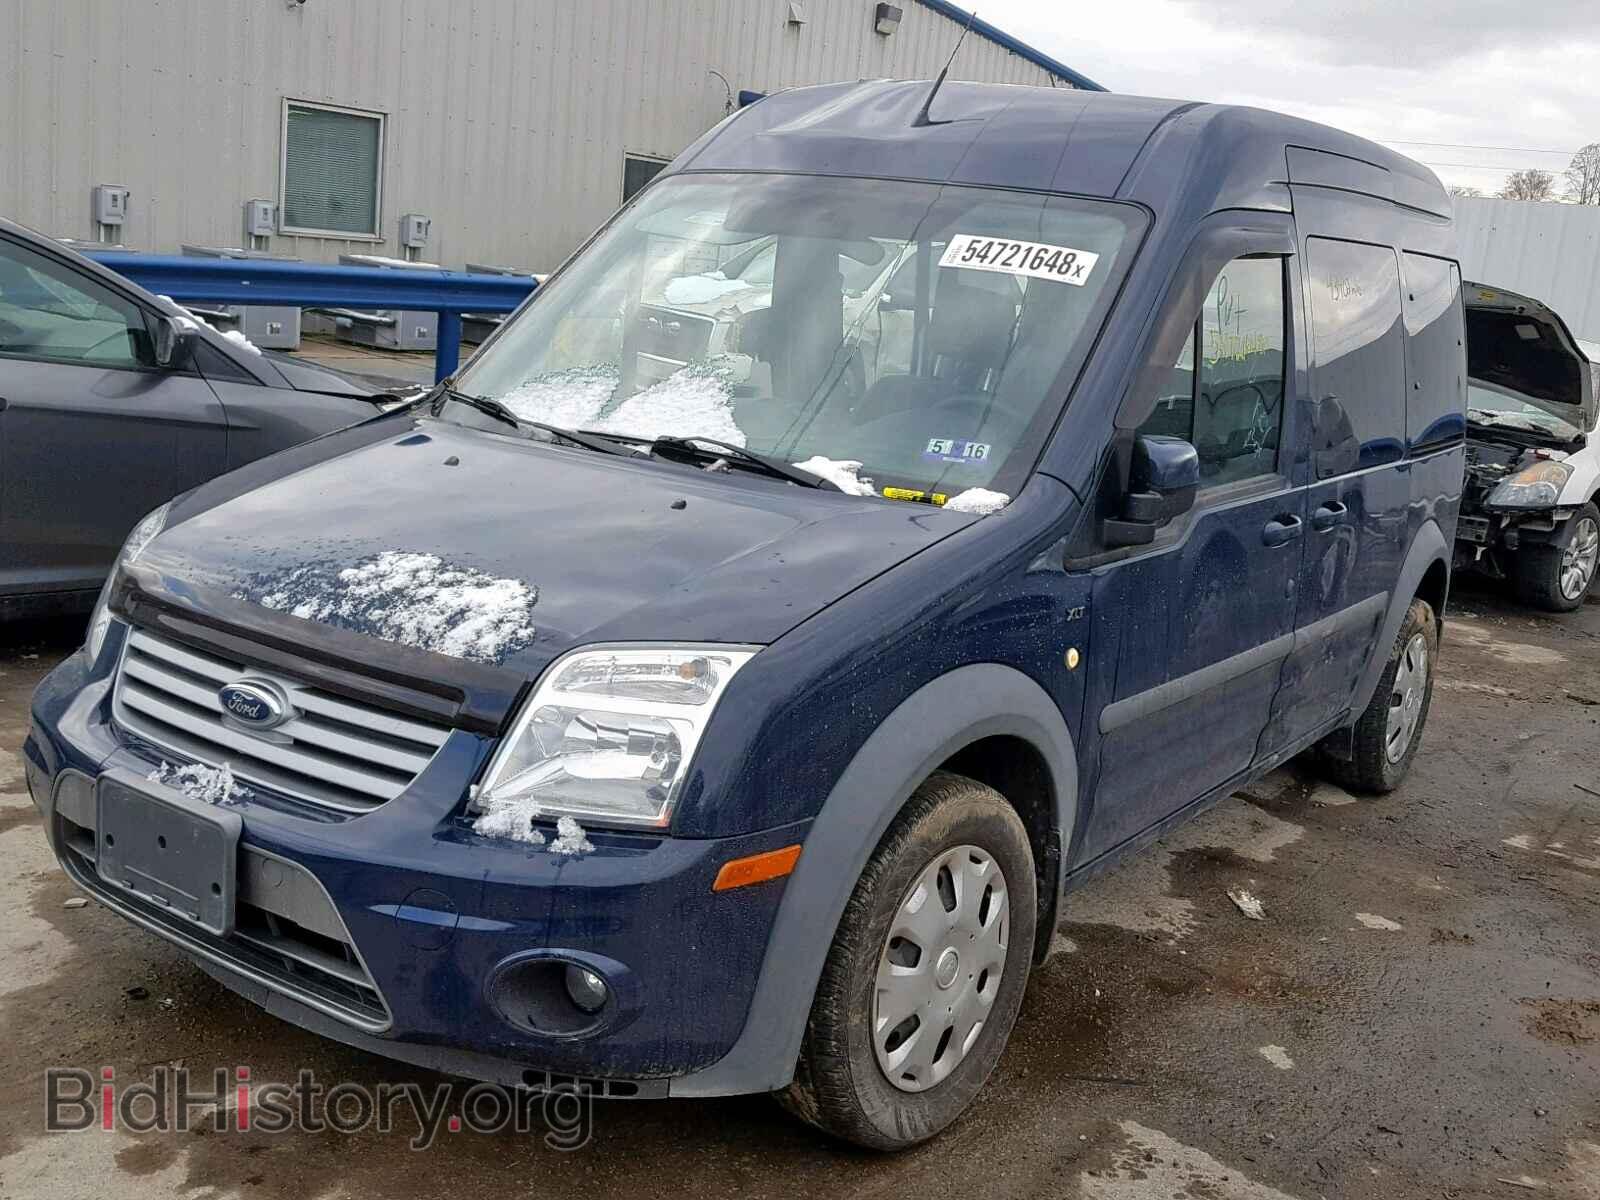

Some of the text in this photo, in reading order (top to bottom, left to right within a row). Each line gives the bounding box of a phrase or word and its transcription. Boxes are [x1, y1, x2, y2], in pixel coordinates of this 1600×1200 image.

[931, 440, 985, 458] 5 16
[227, 690, 261, 718] Ford
